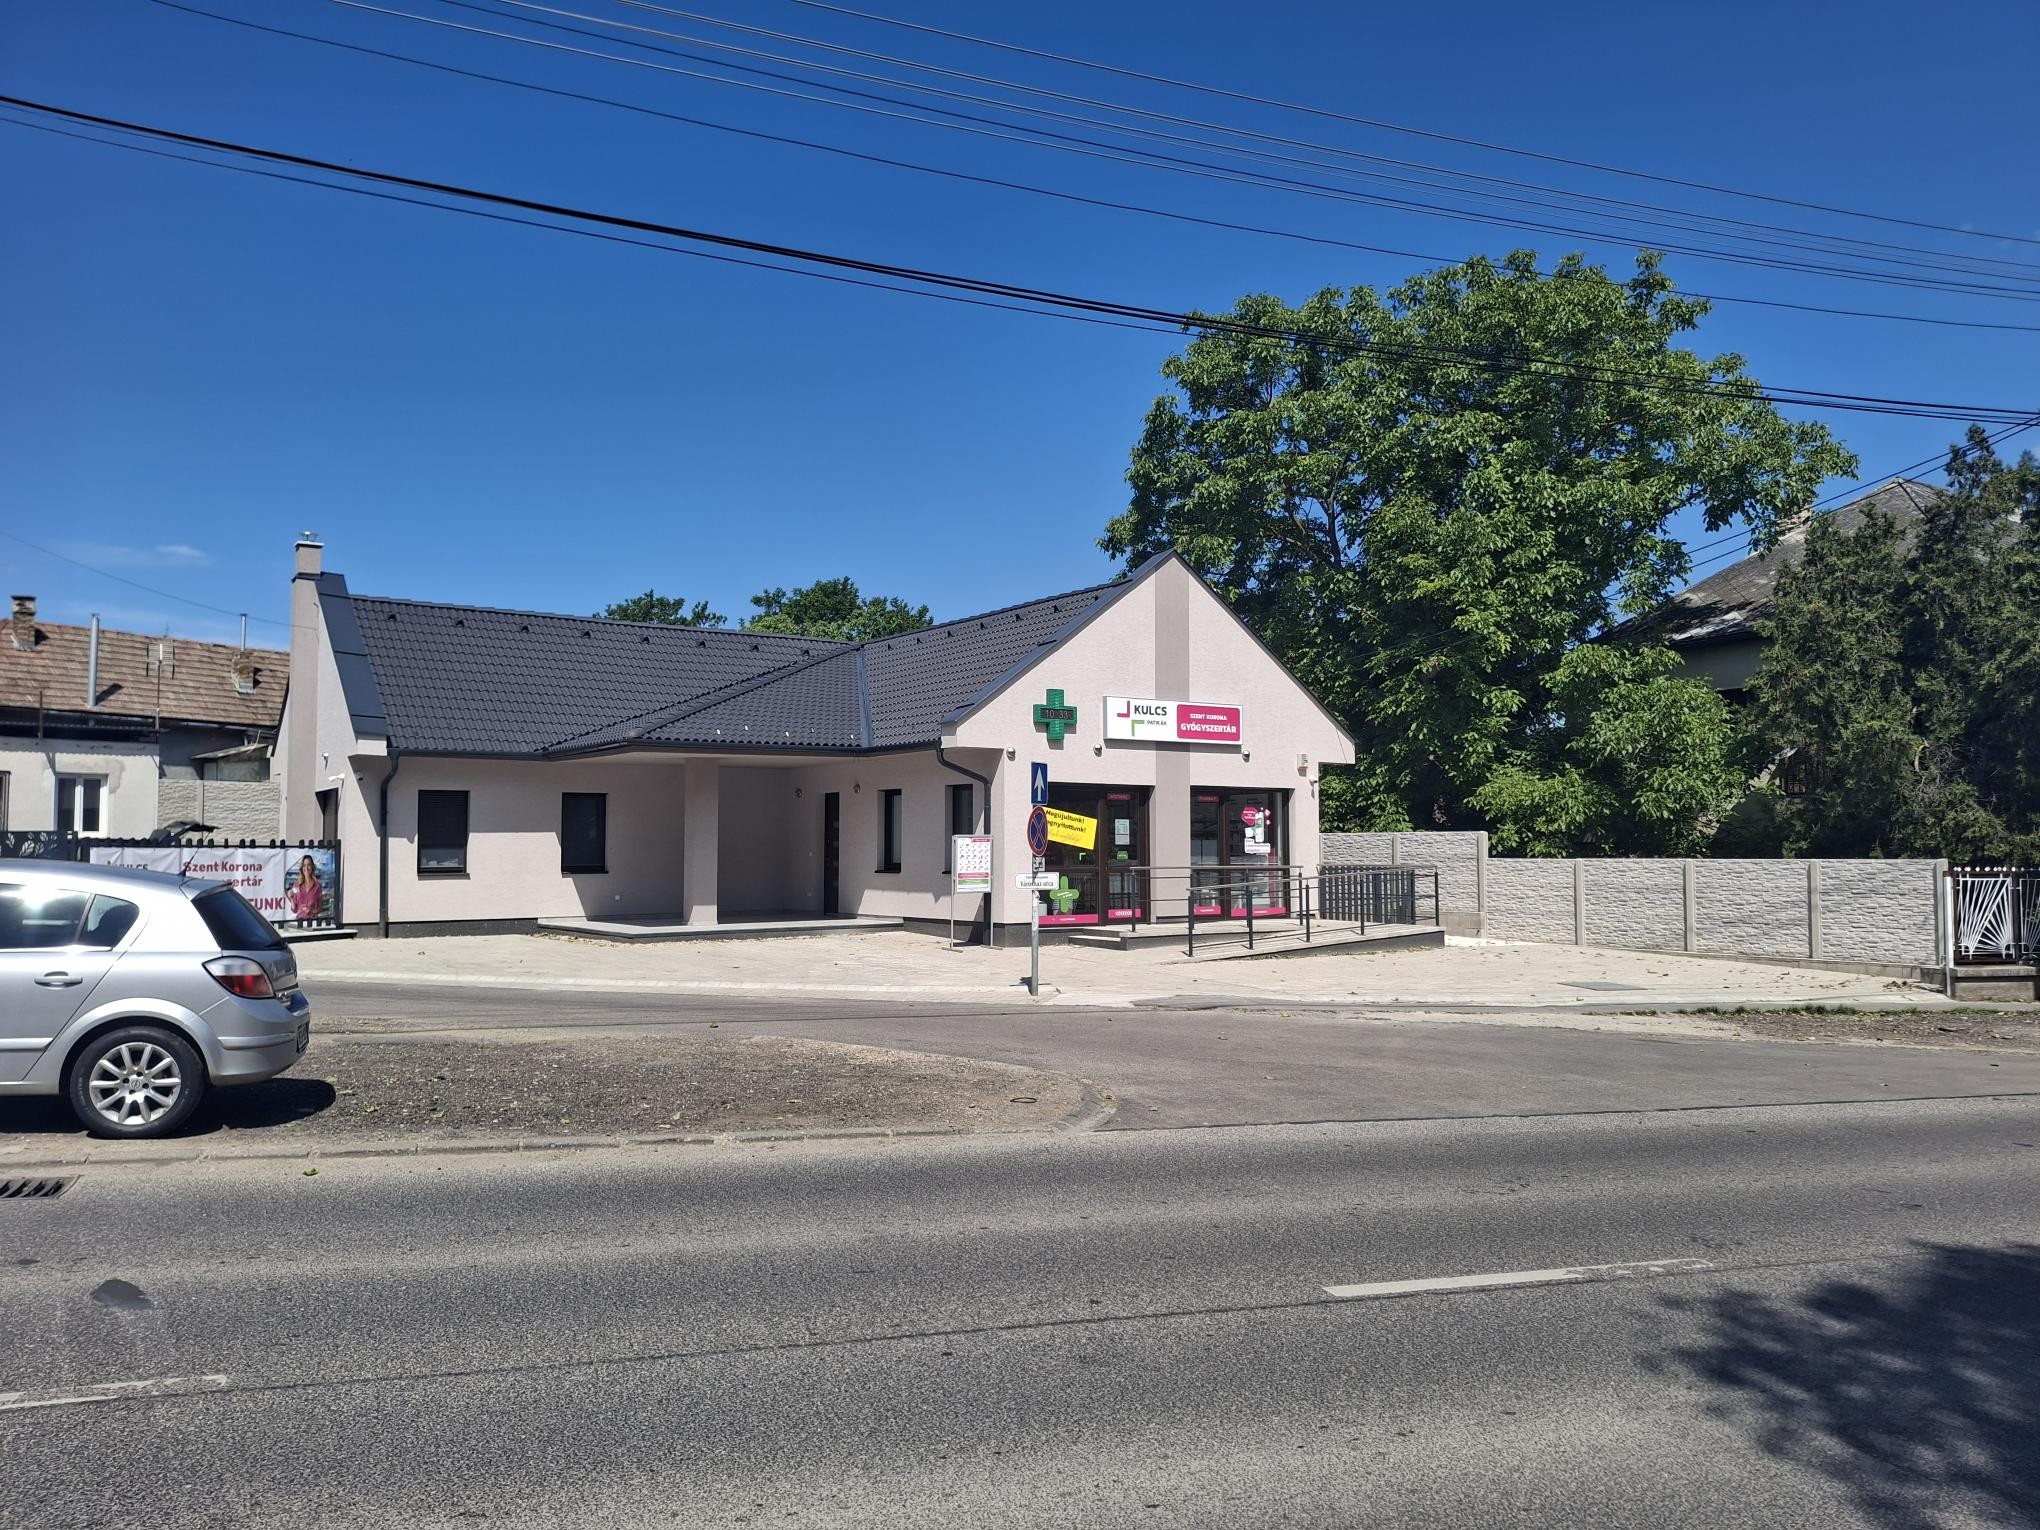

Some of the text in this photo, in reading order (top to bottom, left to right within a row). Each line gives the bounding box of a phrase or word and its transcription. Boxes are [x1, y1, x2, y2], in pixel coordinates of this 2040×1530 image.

[1134, 704, 1168, 716] KULCS
[1180, 721, 1238, 733] GYÓGYSZERTÁR
[183, 860, 263, 873] Szent Korona
